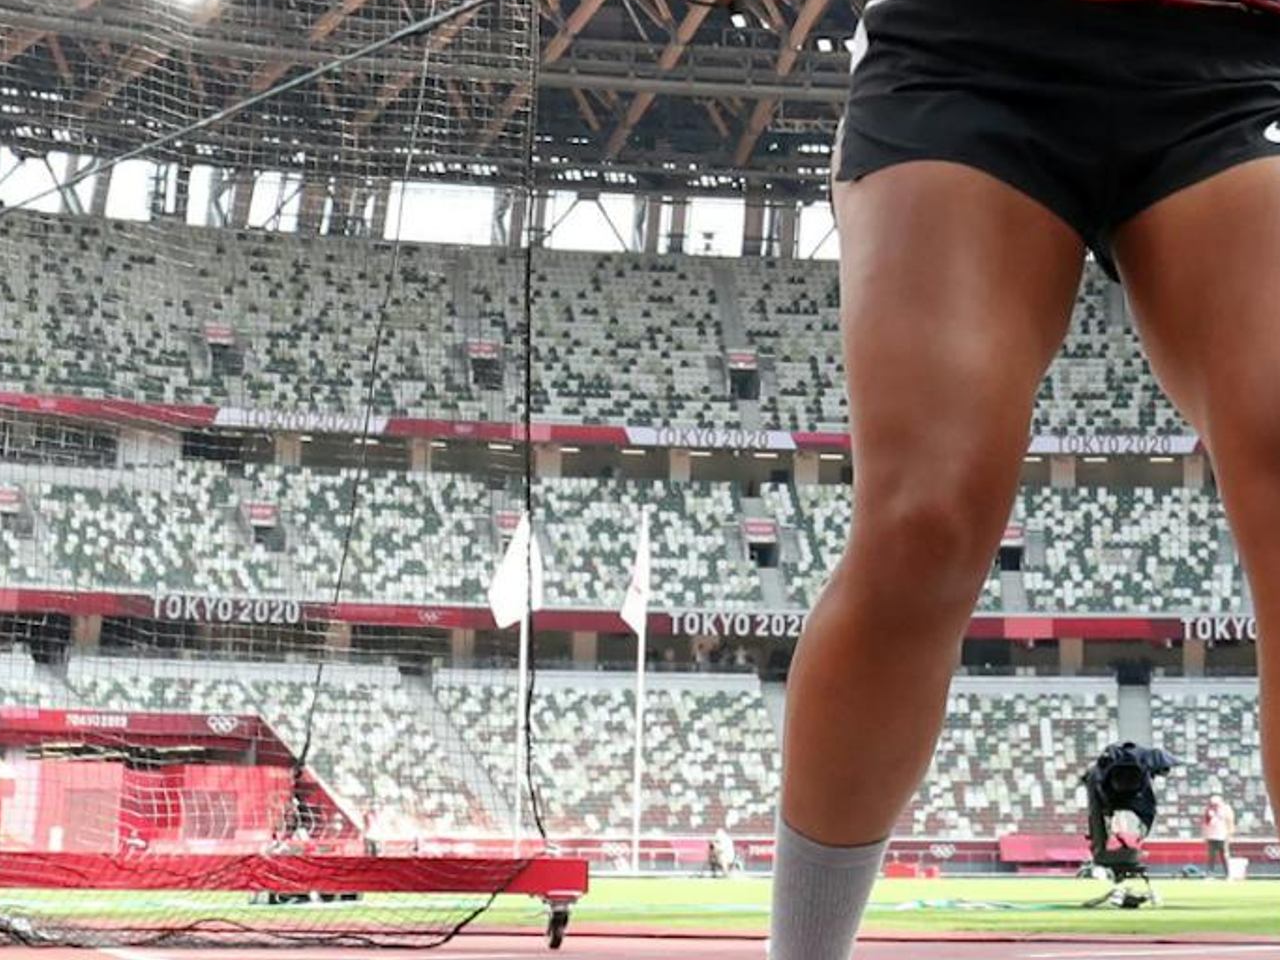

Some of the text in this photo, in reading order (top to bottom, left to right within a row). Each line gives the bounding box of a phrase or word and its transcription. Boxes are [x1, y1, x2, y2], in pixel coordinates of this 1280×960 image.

[655, 426, 770, 449] TOKYO 2020
[1057, 435, 1171, 454] TOKYO 2020
[152, 593, 300, 623] TOKYO 2020
[669, 612, 750, 636] TOKYO
